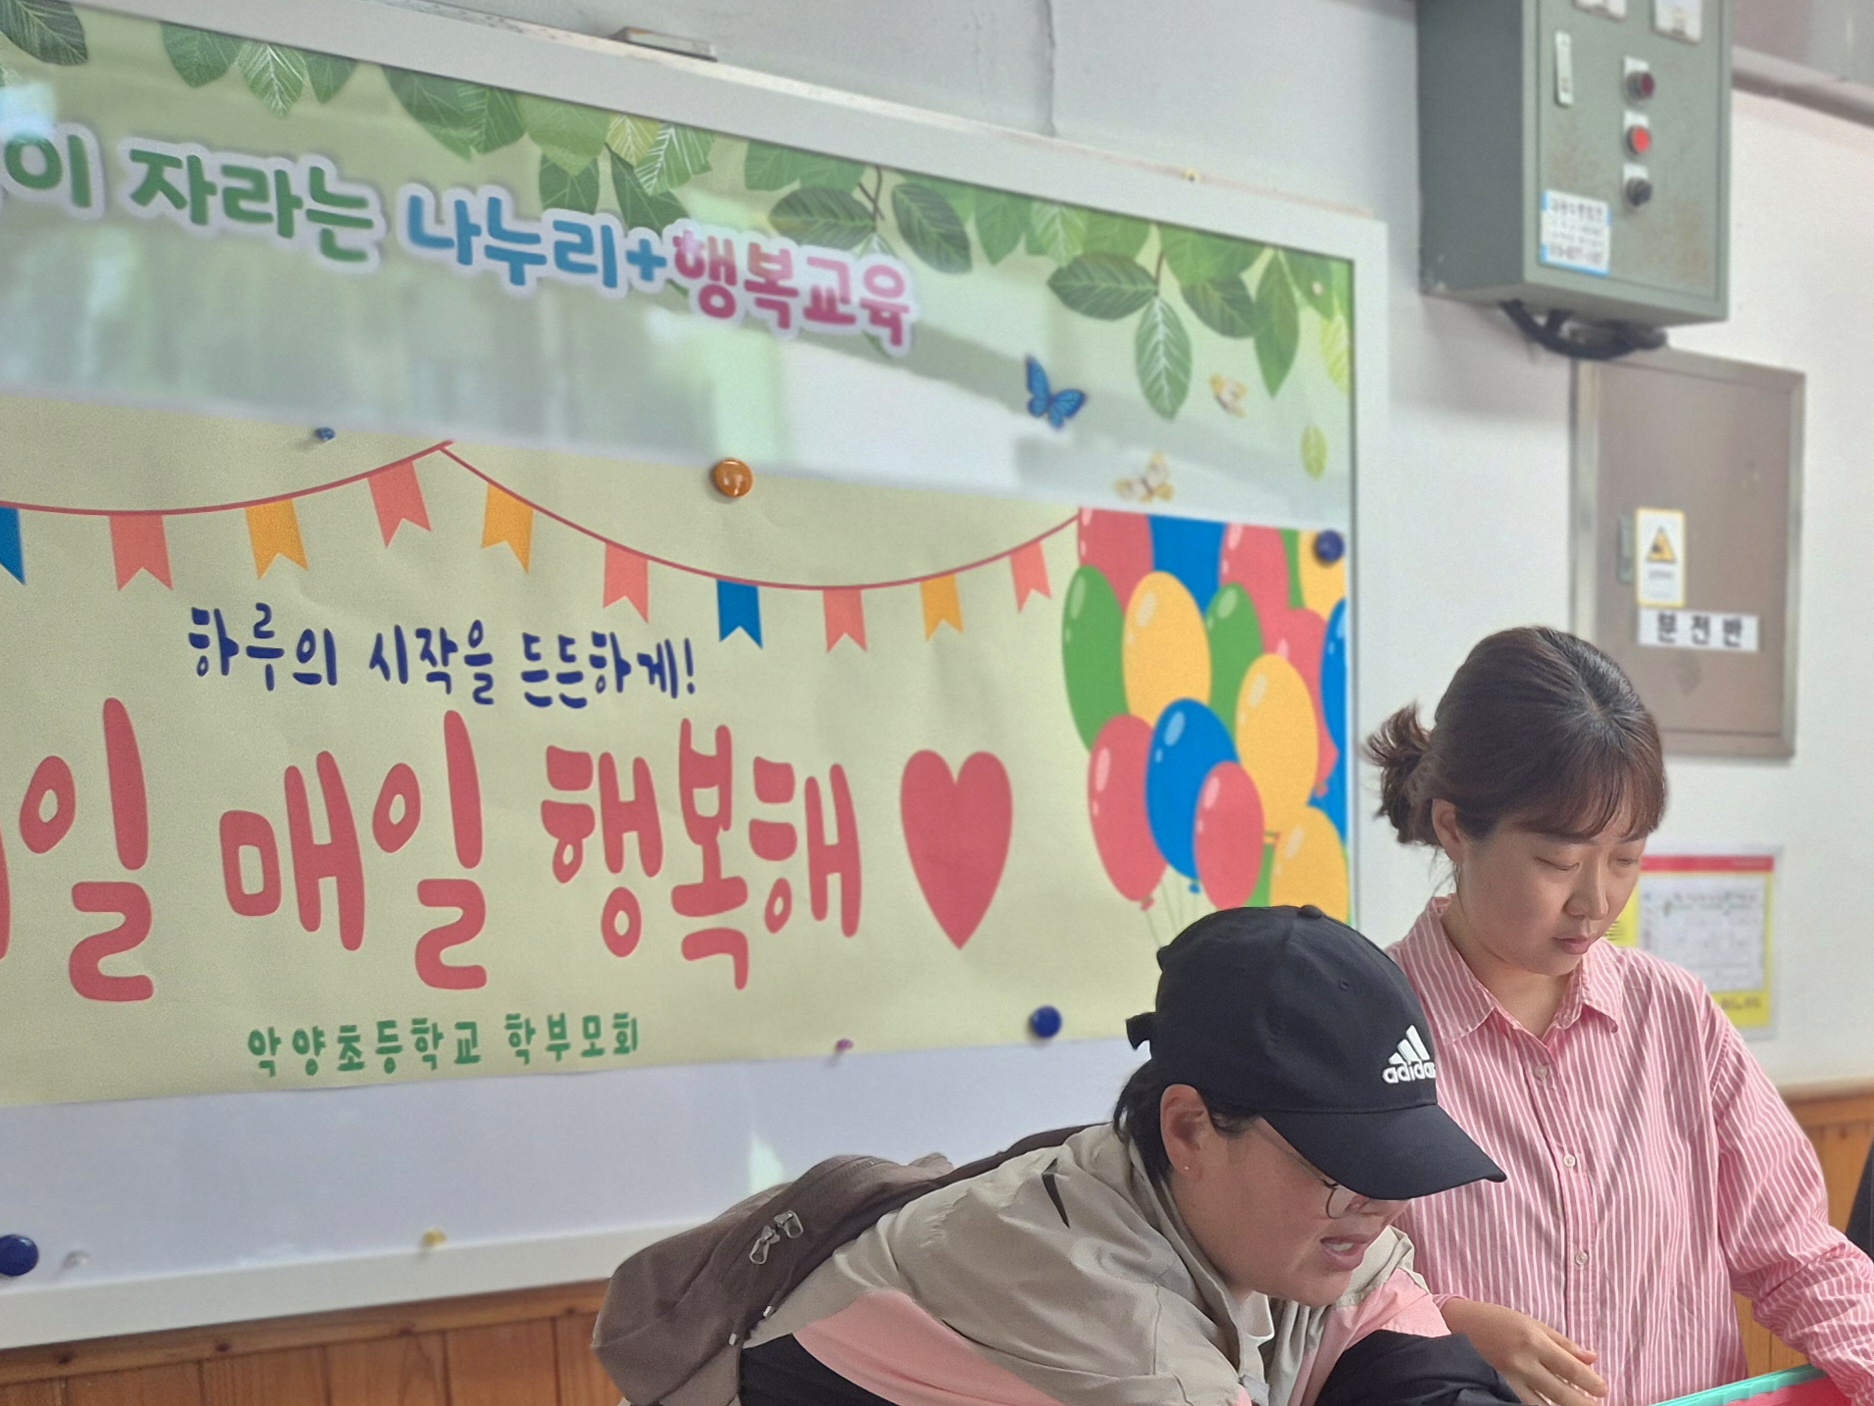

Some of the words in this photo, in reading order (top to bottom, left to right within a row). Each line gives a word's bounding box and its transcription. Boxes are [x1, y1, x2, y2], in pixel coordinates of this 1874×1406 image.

[129, 147, 374, 263] 자라는
[189, 602, 339, 691] 하루의
[368, 618, 495, 706] 시작을
[519, 630, 697, 710] 든든하게!
[0, 697, 154, 1002] 일
[218, 710, 489, 990] 매일
[540, 717, 863, 990] 행복해
[246, 1015, 483, 1077] 악양초등학교
[503, 1011, 642, 1064] 학부모회
